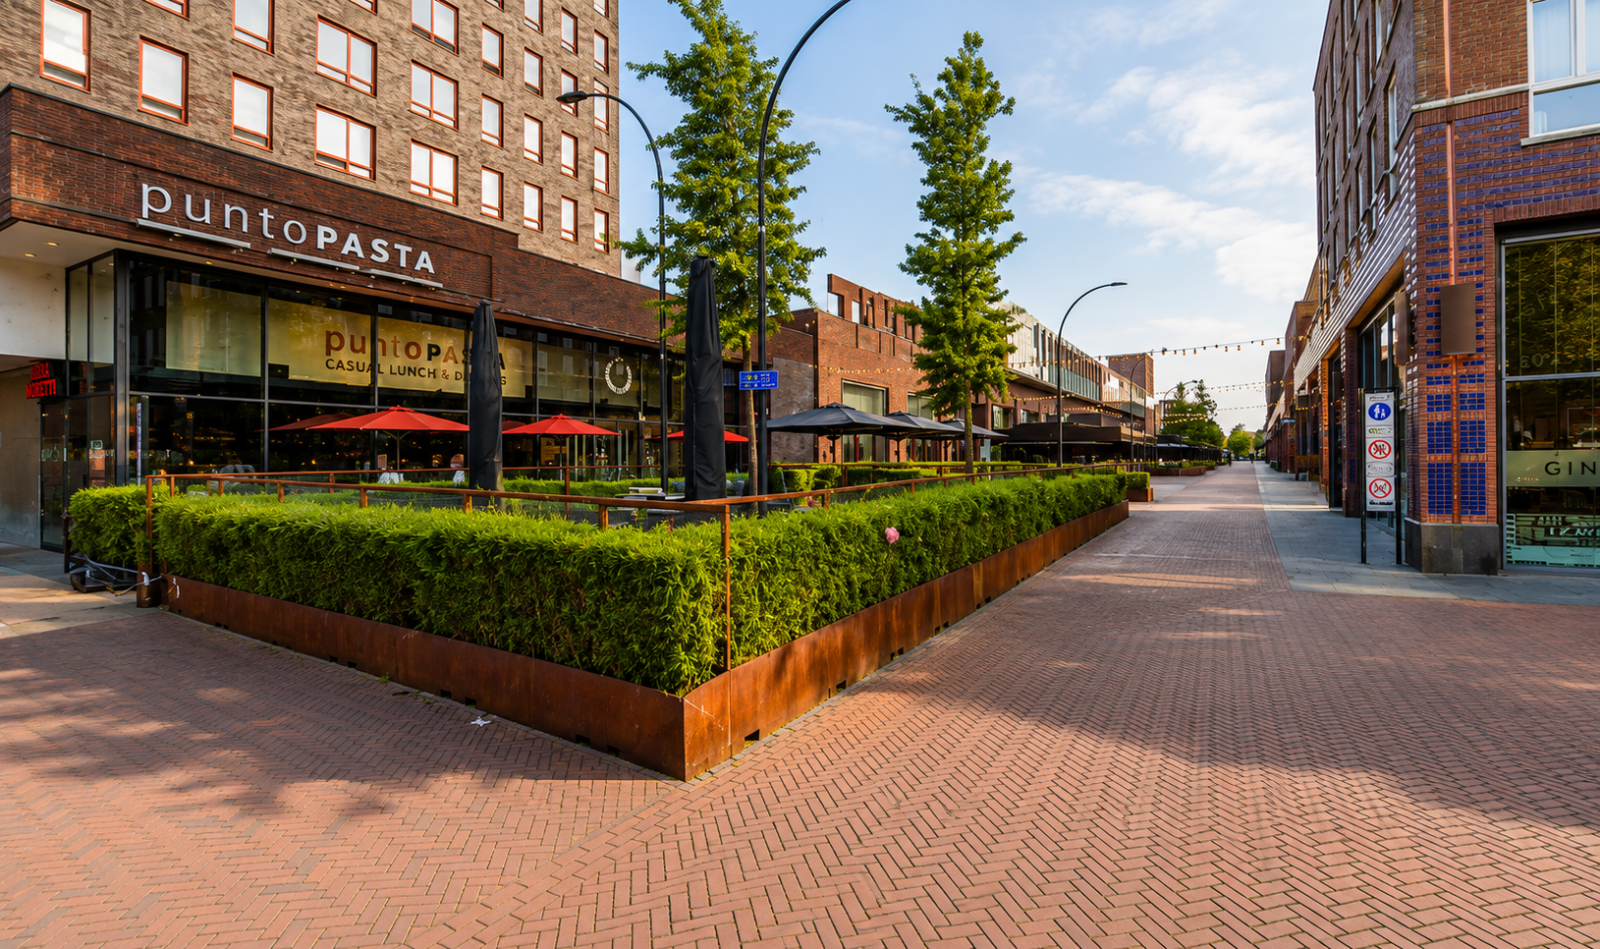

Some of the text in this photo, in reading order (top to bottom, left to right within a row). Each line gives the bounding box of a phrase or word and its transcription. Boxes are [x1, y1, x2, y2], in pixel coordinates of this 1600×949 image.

[141, 182, 435, 274] puntoPASTA
[389, 364, 436, 379] LUNCH
[441, 369, 450, 380] &
[1544, 461, 1597, 476] GIN
